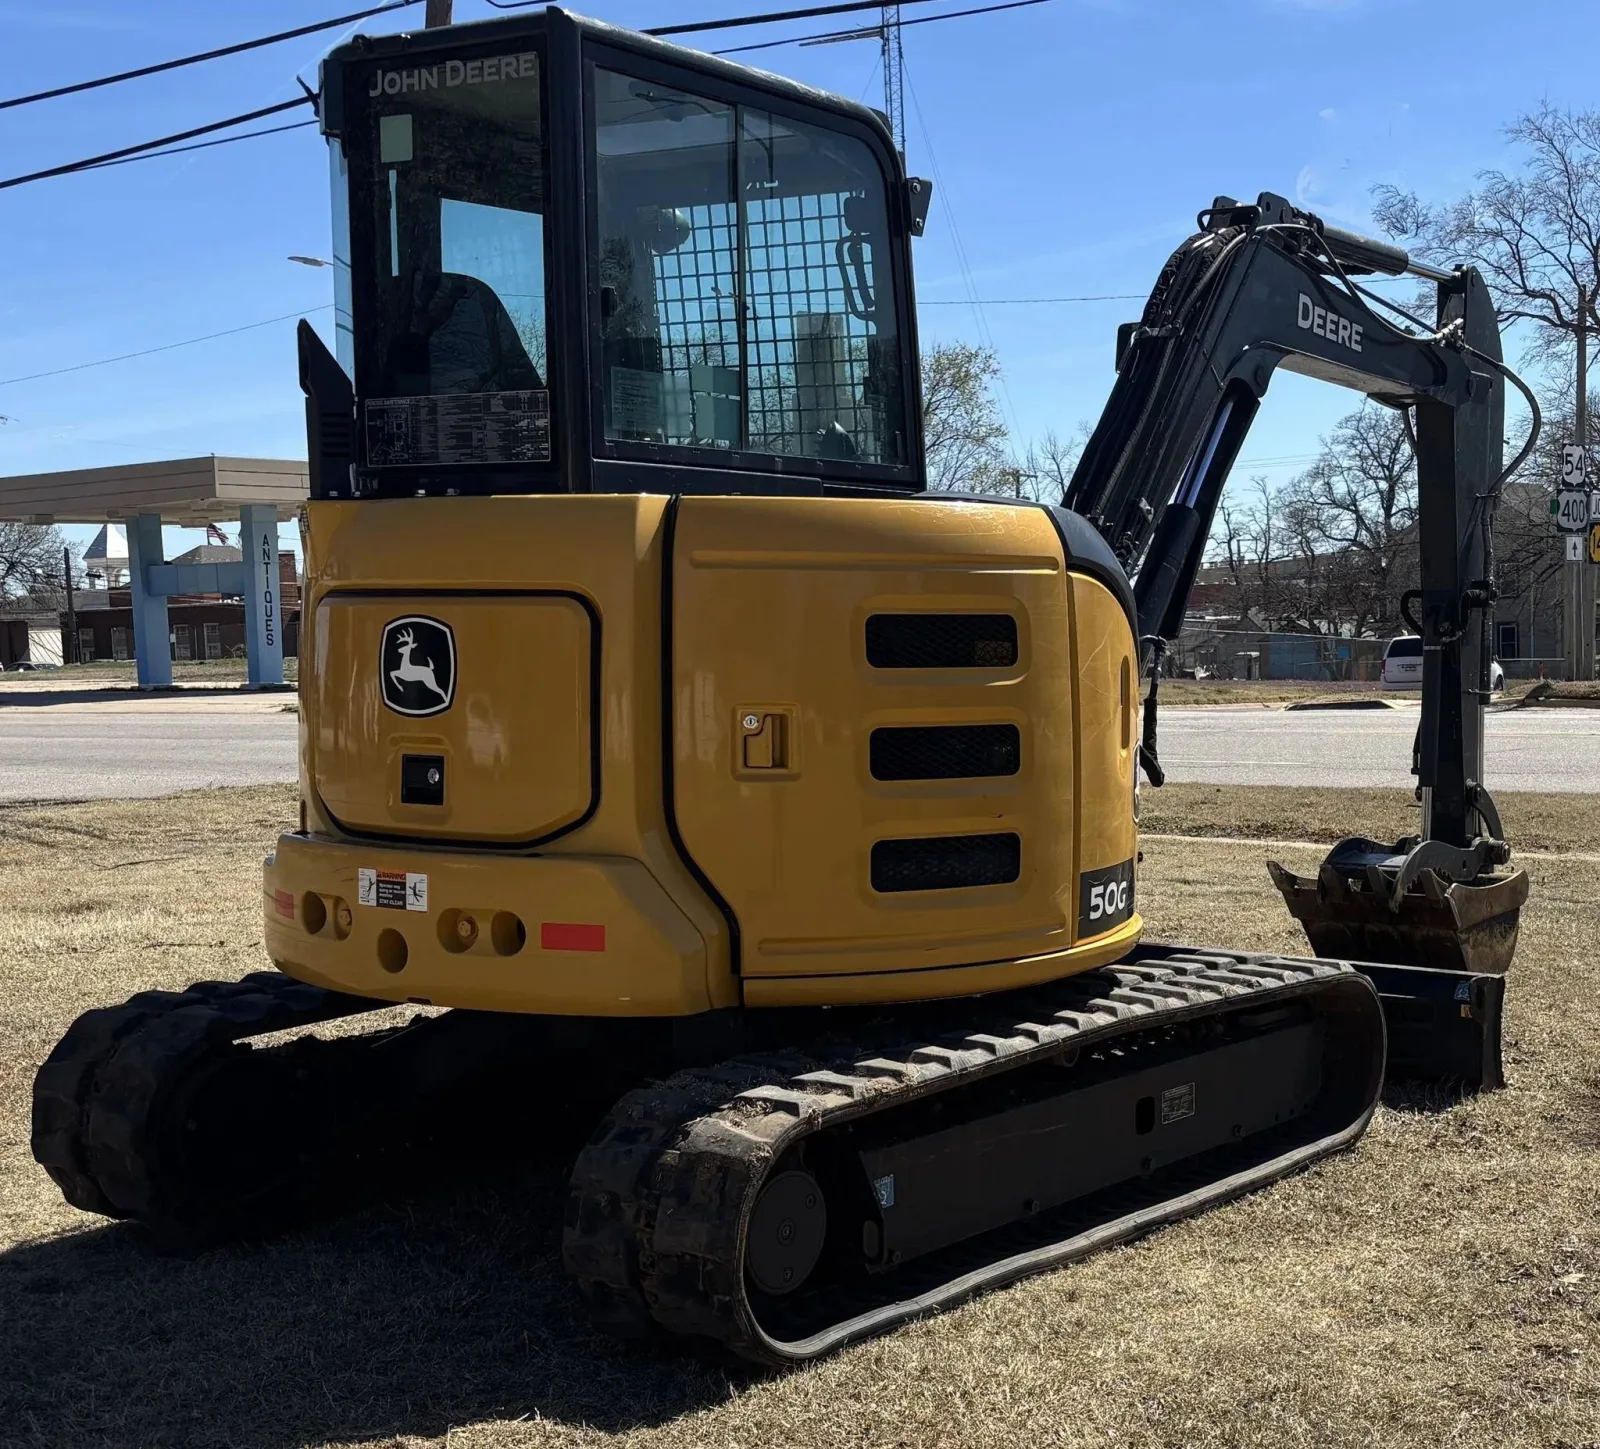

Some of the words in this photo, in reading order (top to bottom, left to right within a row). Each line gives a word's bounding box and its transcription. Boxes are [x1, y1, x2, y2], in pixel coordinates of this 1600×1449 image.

[369, 67, 438, 97] JOHN
[445, 54, 536, 87] DEERE
[1297, 292, 1364, 353] DEERE
[1564, 453, 1584, 477] 54
[1561, 499, 1585, 523] 400
[262, 533, 274, 646] ANTIQUES
[382, 872, 406, 880] WARNING
[1089, 880, 1127, 921] 50G
